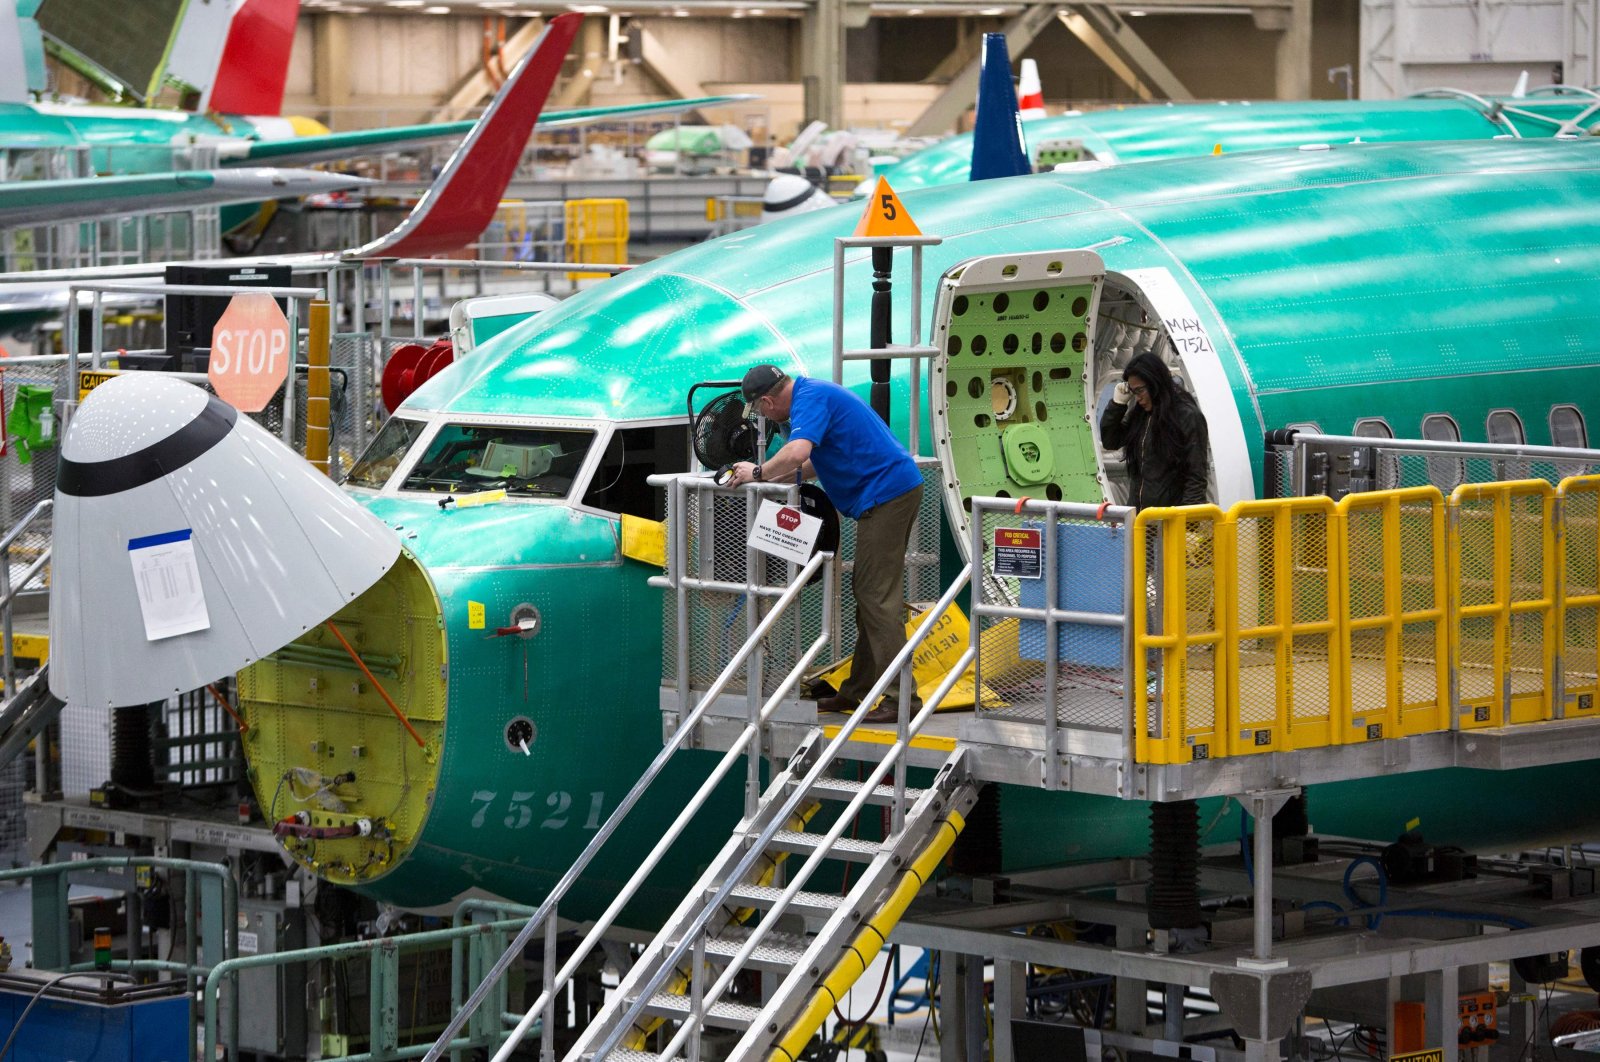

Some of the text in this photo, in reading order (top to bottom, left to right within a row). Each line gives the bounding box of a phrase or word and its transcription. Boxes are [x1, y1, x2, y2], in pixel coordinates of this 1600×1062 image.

[882, 194, 896, 220] 5
[1165, 318, 1205, 334] MAX
[212, 328, 286, 375] STOP
[1176, 336, 1214, 354] 7521
[780, 514, 798, 523] STOP
[782, 532, 802, 543] CHECKED
[470, 790, 604, 829] 7521
